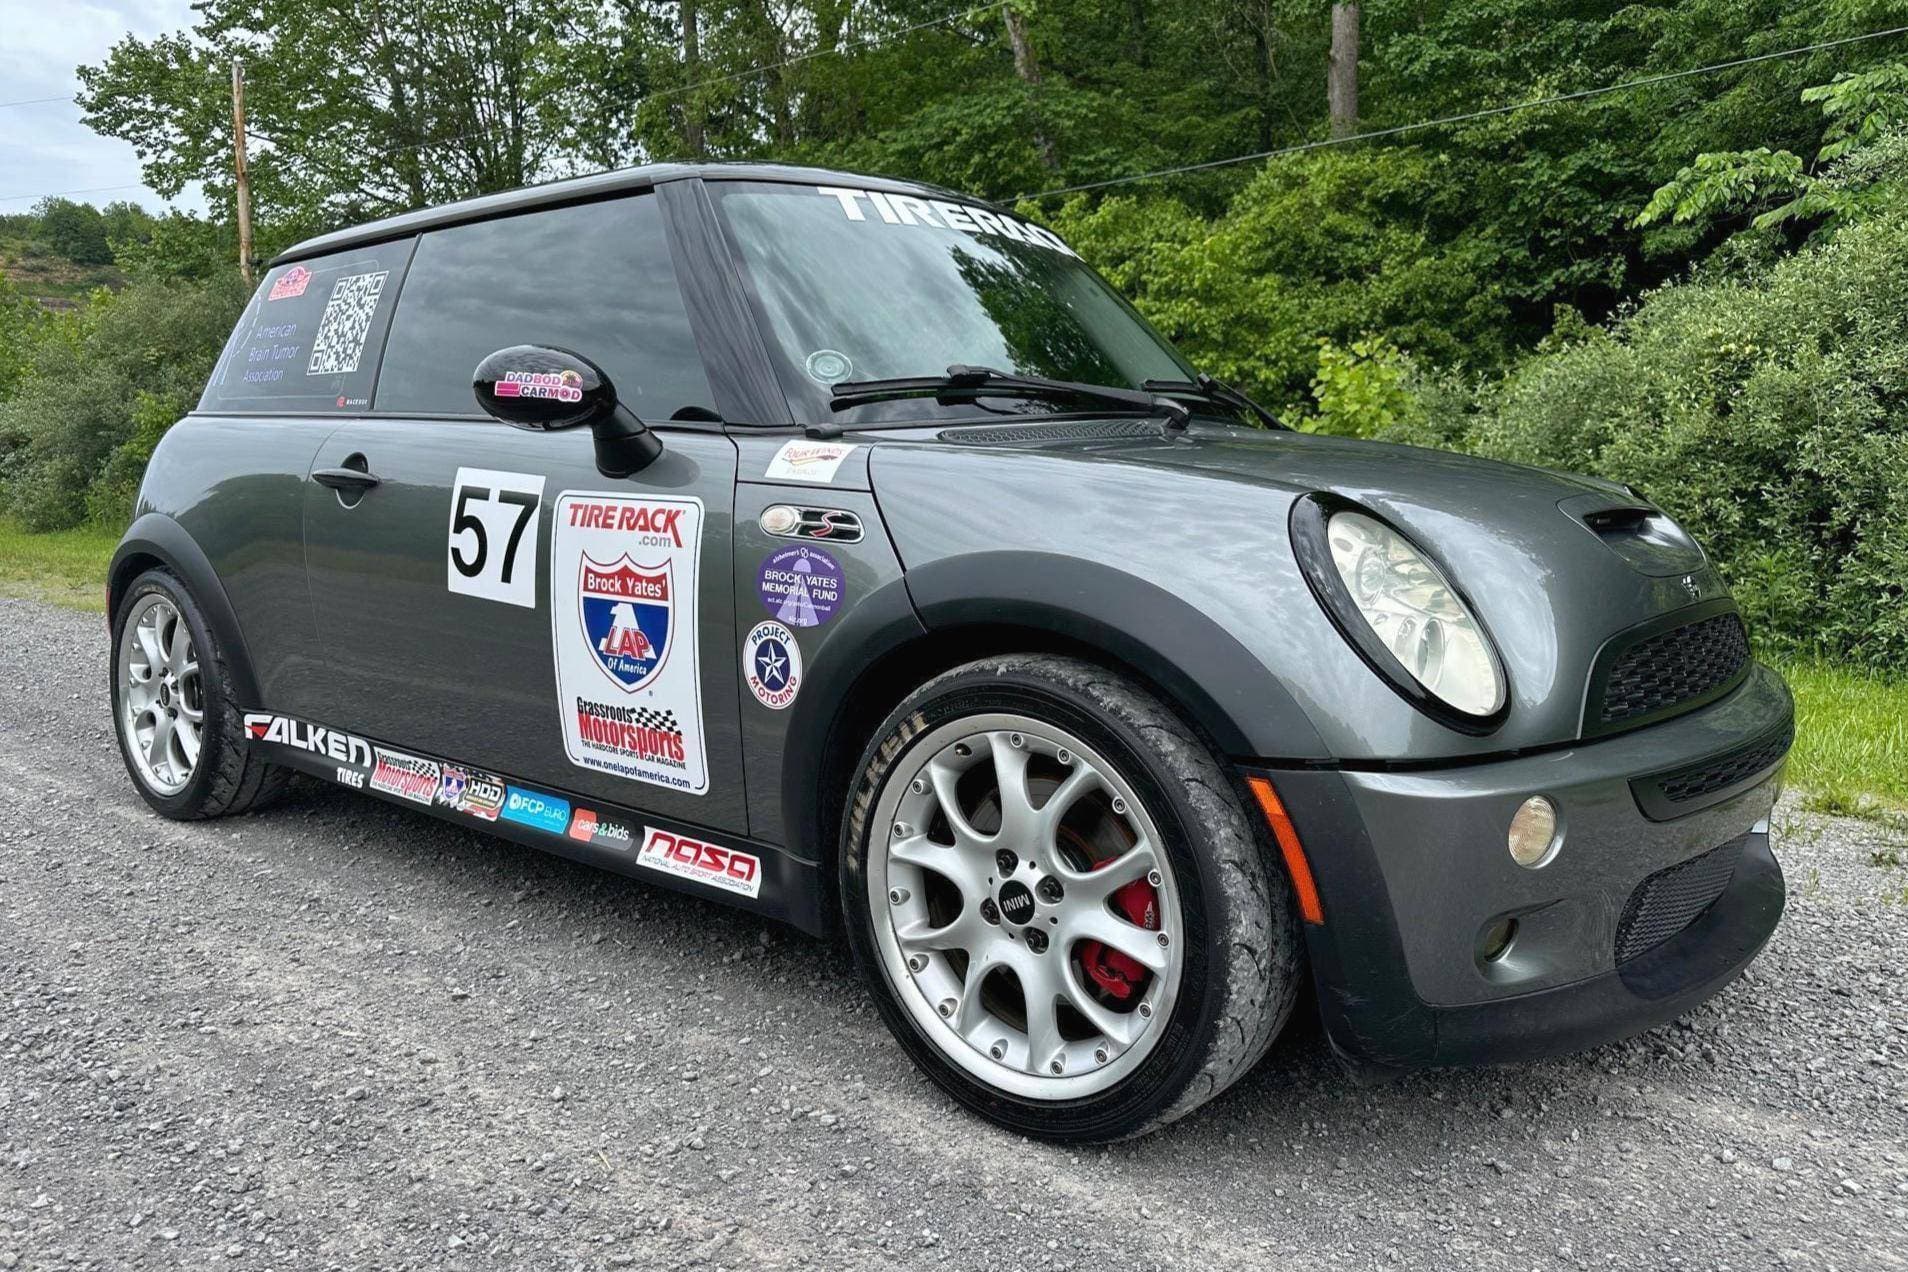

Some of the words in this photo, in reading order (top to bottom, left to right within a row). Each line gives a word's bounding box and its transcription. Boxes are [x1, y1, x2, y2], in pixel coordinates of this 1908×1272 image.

[256, 323, 297, 339] American
[249, 346, 270, 362] Brain
[272, 344, 300, 361] Tumor
[242, 369, 284, 383] Association
[506, 372, 562, 386] DADBOD
[521, 386, 581, 401] CARMOD
[450, 484, 540, 585] 57
[638, 535, 671, 548] .com
[587, 573, 622, 593] Brock
[626, 576, 666, 597] Yates'
[764, 569, 801, 584] BROCK
[805, 575, 838, 589] YATES
[762, 581, 809, 597] MEMORIAL
[812, 588, 838, 601] FUND
[603, 625, 651, 660] LAP
[751, 625, 791, 646] PROJECT
[607, 658, 618, 670] Of
[618, 659, 647, 675] America
[750, 675, 797, 705] MOTORING
[576, 696, 634, 724] Grassroots
[244, 713, 372, 768] FALKEN
[577, 712, 685, 762] Motorsports
[582, 739, 591, 749] THE
[592, 741, 619, 754] HARDCORE
[619, 747, 639, 760] SPORTS
[644, 753, 656, 763] CAR
[656, 757, 687, 770] MAGAZINE
[336, 766, 365, 789] TIRES
[373, 759, 438, 796] Motorsports
[583, 756, 691, 788] www.onelapofamerica.com
[520, 797, 545, 815] FCP
[543, 805, 567, 821] EURO
[577, 819, 630, 841] cars&bids
[642, 854, 670, 869] NATIONAL
[672, 864, 690, 874] AUTO
[711, 874, 754, 893] ASSOCIATION
[1003, 893, 1031, 912] MINI
